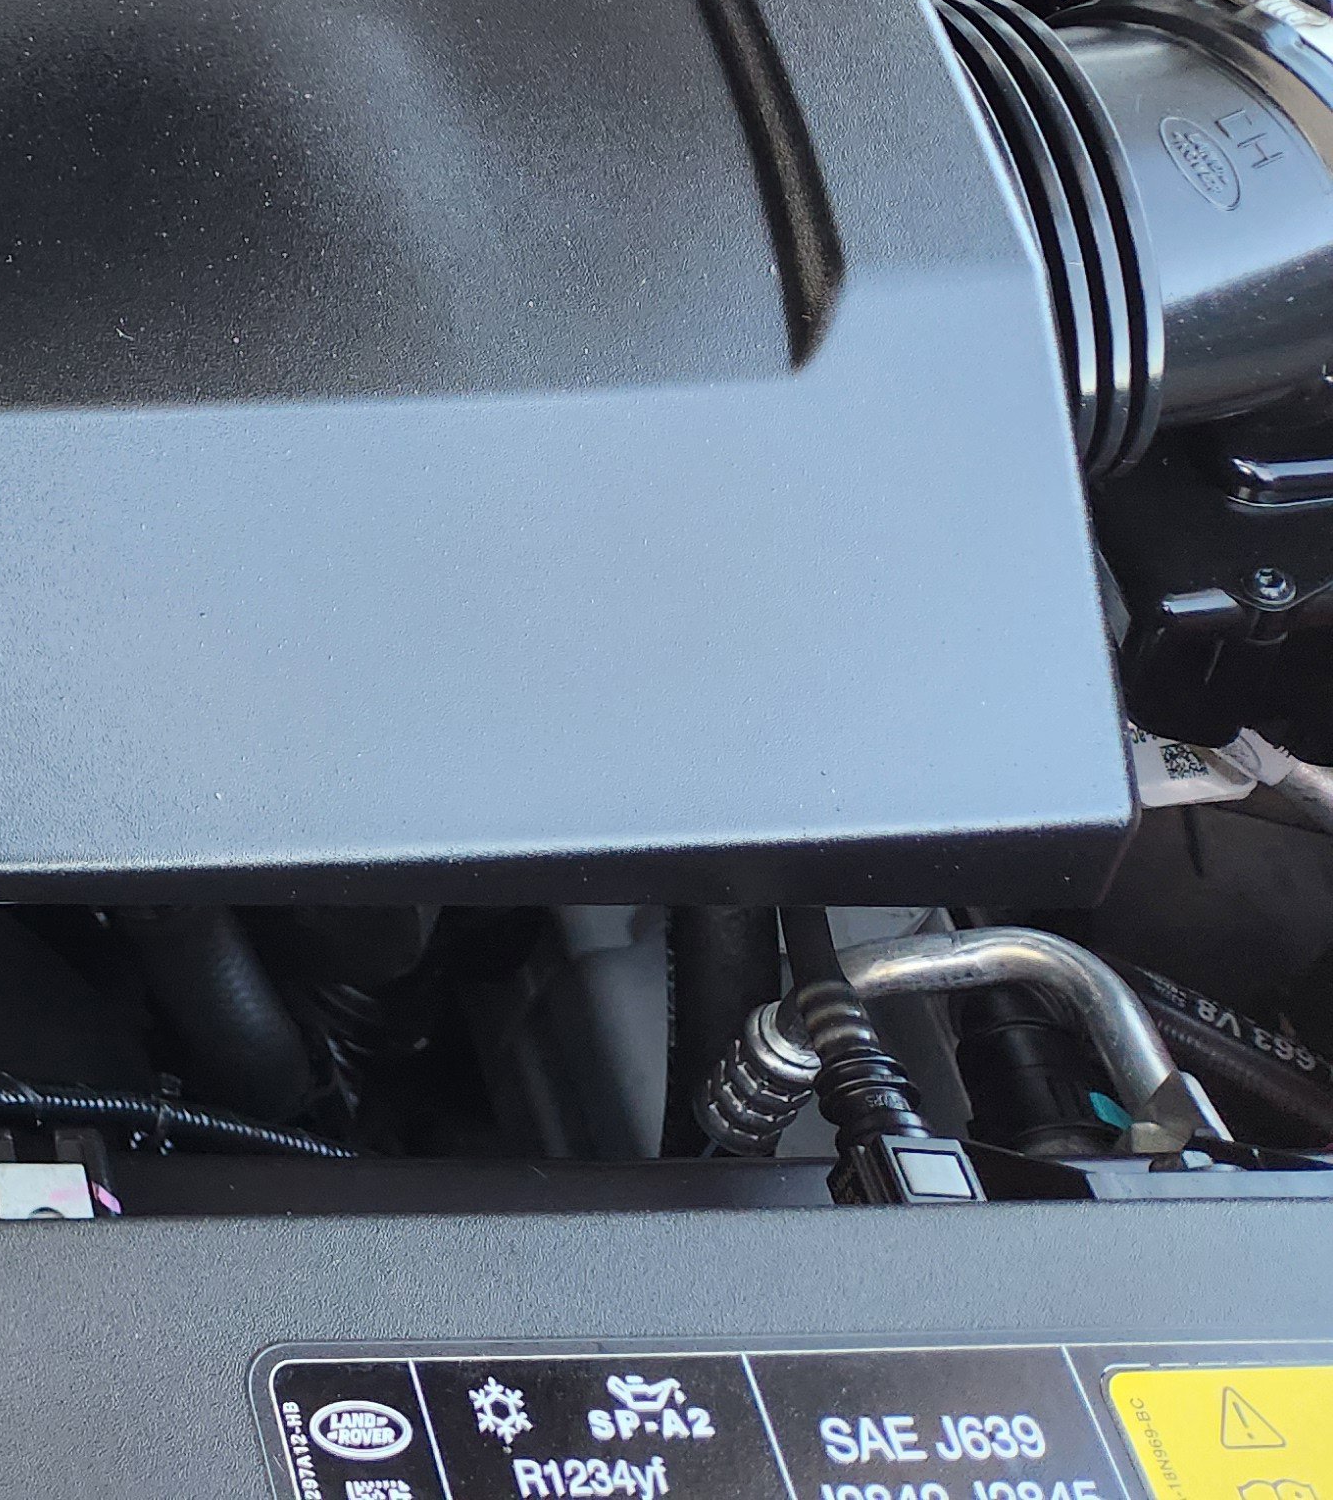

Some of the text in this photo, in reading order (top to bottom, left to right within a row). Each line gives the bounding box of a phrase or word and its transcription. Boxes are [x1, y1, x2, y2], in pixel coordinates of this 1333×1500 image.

[1198, 999, 1241, 1039] V8
[329, 1413, 376, 1430] LAND
[338, 1427, 396, 1446] ROVER
[587, 1407, 716, 1441] SP-A2
[819, 1414, 1046, 1464] SAE J639
[512, 1455, 670, 1500] R1234yf
